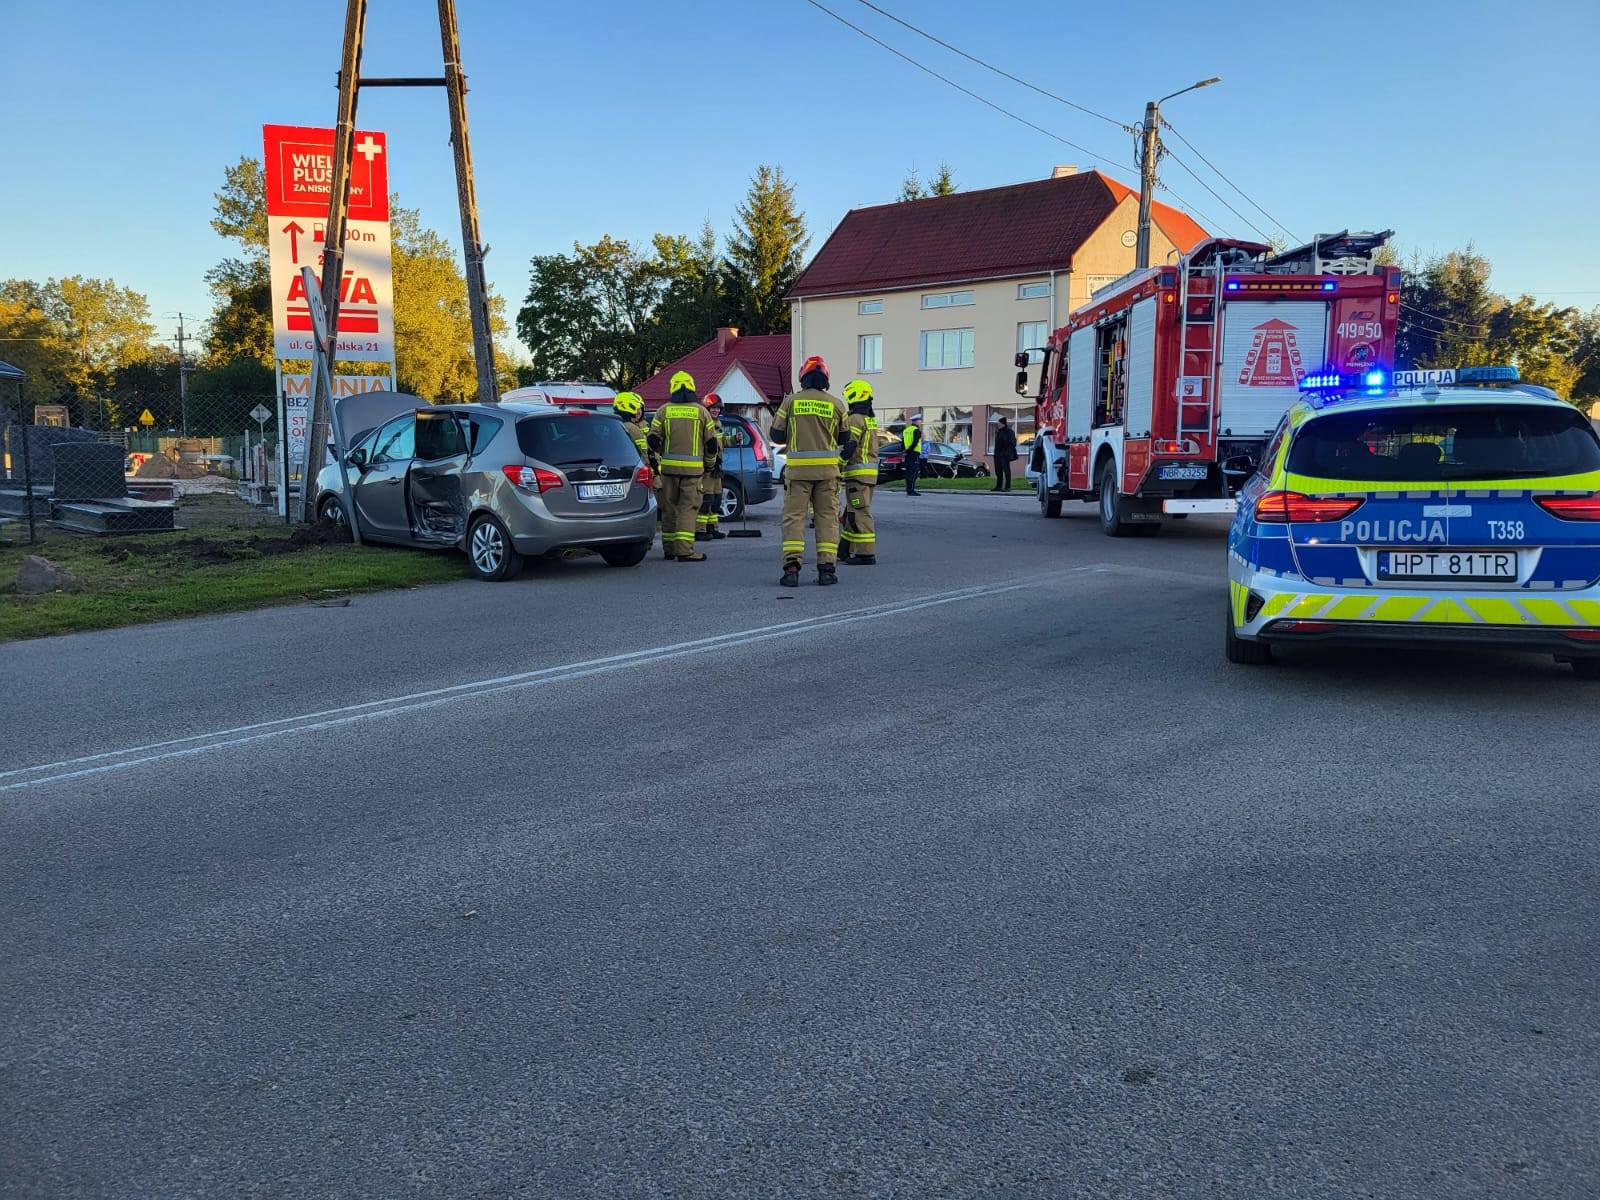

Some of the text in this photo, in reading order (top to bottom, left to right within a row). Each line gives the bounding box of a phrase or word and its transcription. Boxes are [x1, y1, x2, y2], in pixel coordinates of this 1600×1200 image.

[293, 184, 306, 192] ZA
[362, 231, 376, 242] m
[289, 340, 302, 350] ul.
[365, 342, 379, 352] 21
[1393, 369, 1454, 385] POLICJA
[1163, 468, 1207, 479] NBR 23255
[1340, 519, 1446, 542] POLICJA
[1487, 520, 1525, 541] T358
[1394, 554, 1439, 575] HPT
[1448, 554, 1509, 575] 81TR
